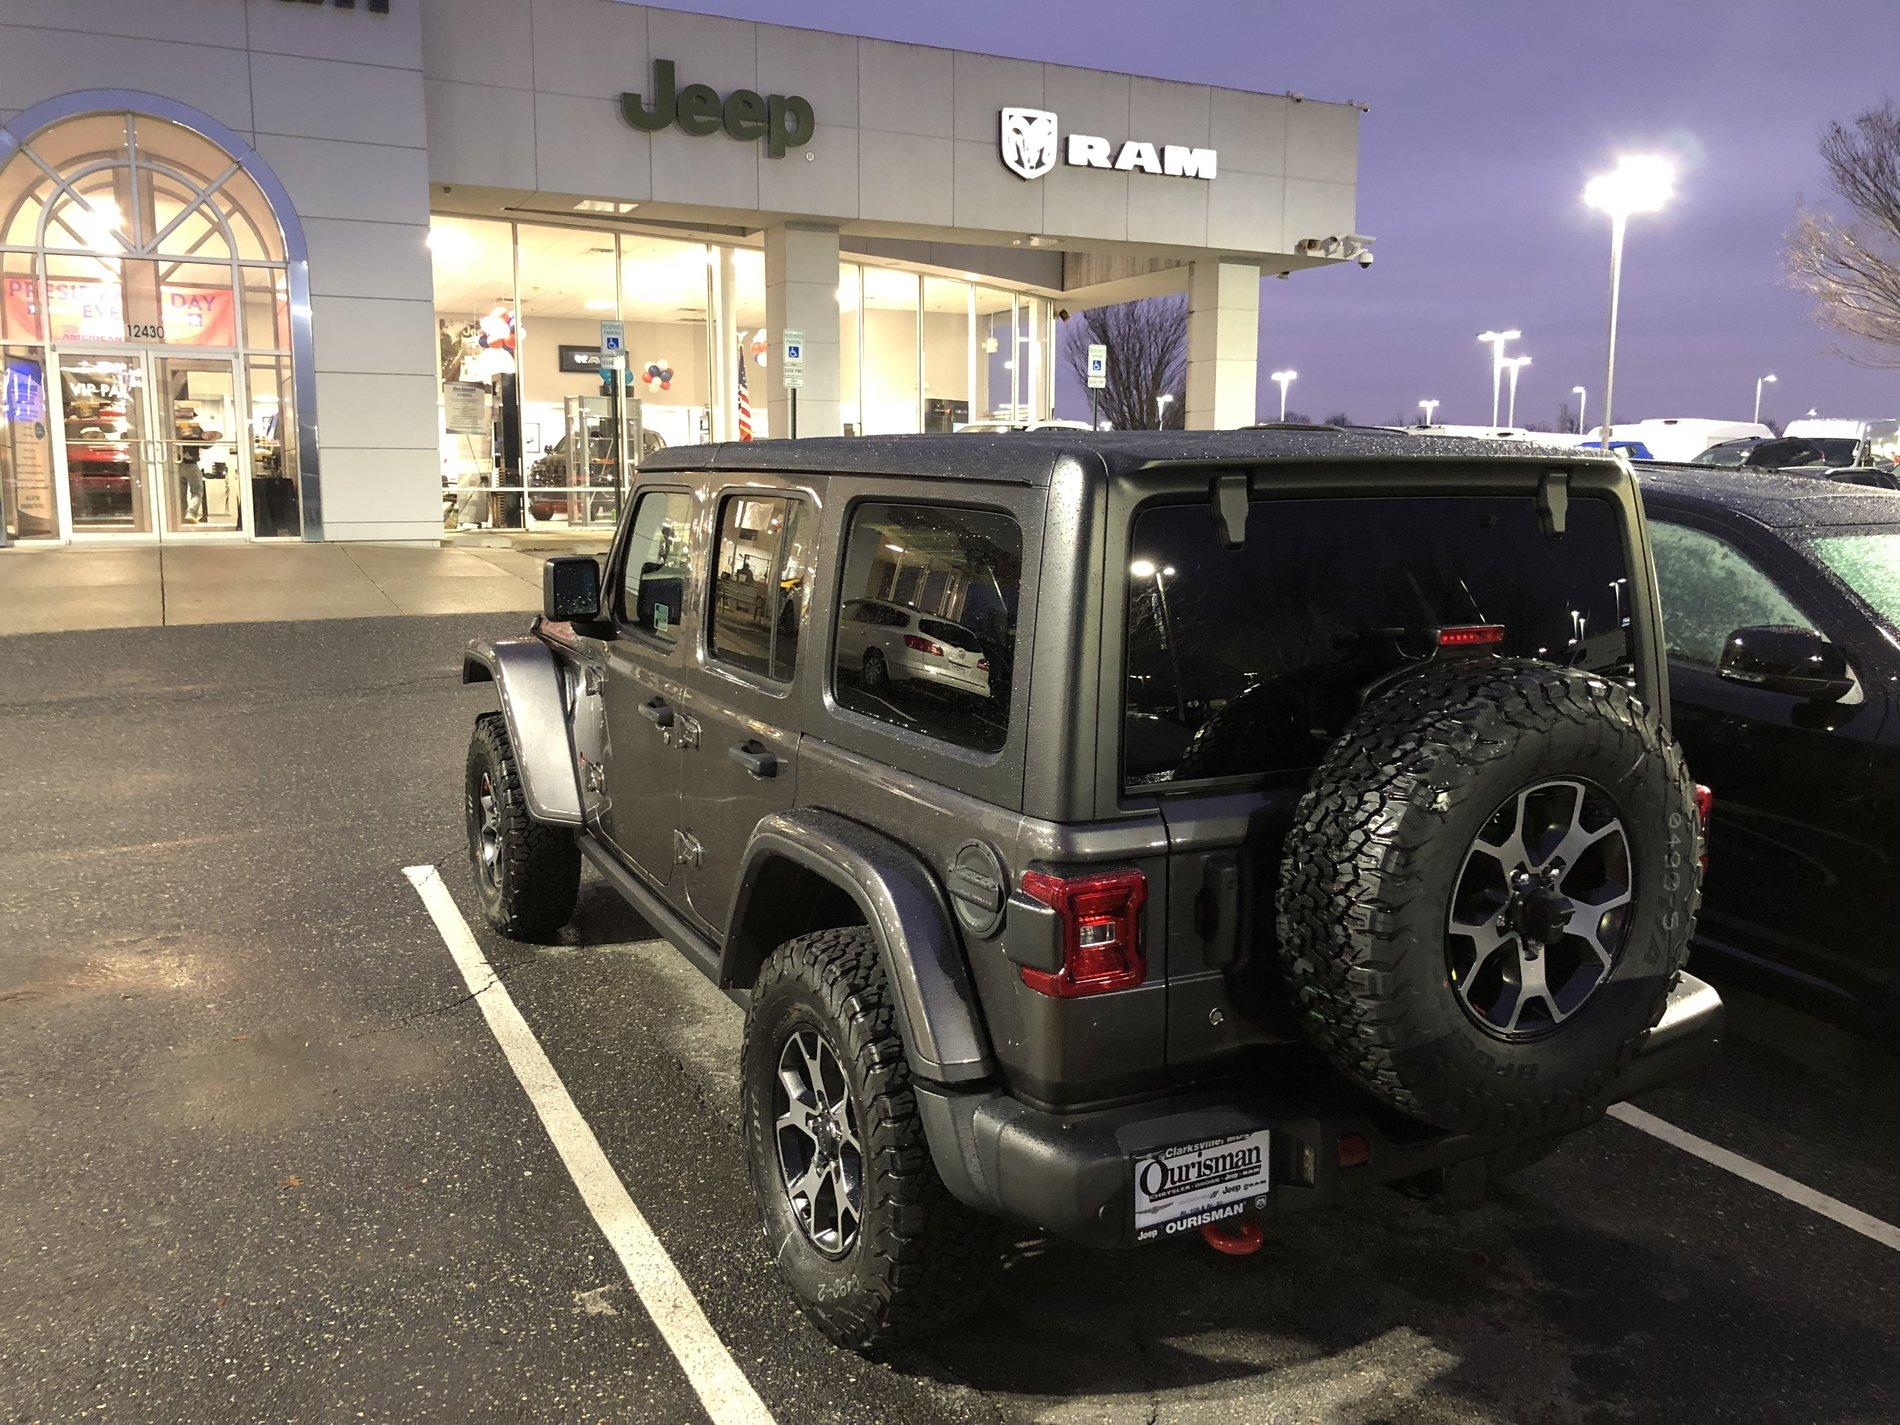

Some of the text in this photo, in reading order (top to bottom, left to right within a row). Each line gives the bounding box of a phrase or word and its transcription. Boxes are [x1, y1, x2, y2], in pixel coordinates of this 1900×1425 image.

[620, 58, 815, 159] Jeep
[1066, 134, 1218, 179] RAM
[126, 324, 164, 339] 12430
[1139, 1145, 1262, 1197] Ourisman
[1222, 1184, 1241, 1195] Jeep
[1149, 1185, 1191, 1200] CHRYSLER
[1138, 1228, 1158, 1240] Jeep
[1165, 1202, 1244, 1234] OURISMAN
